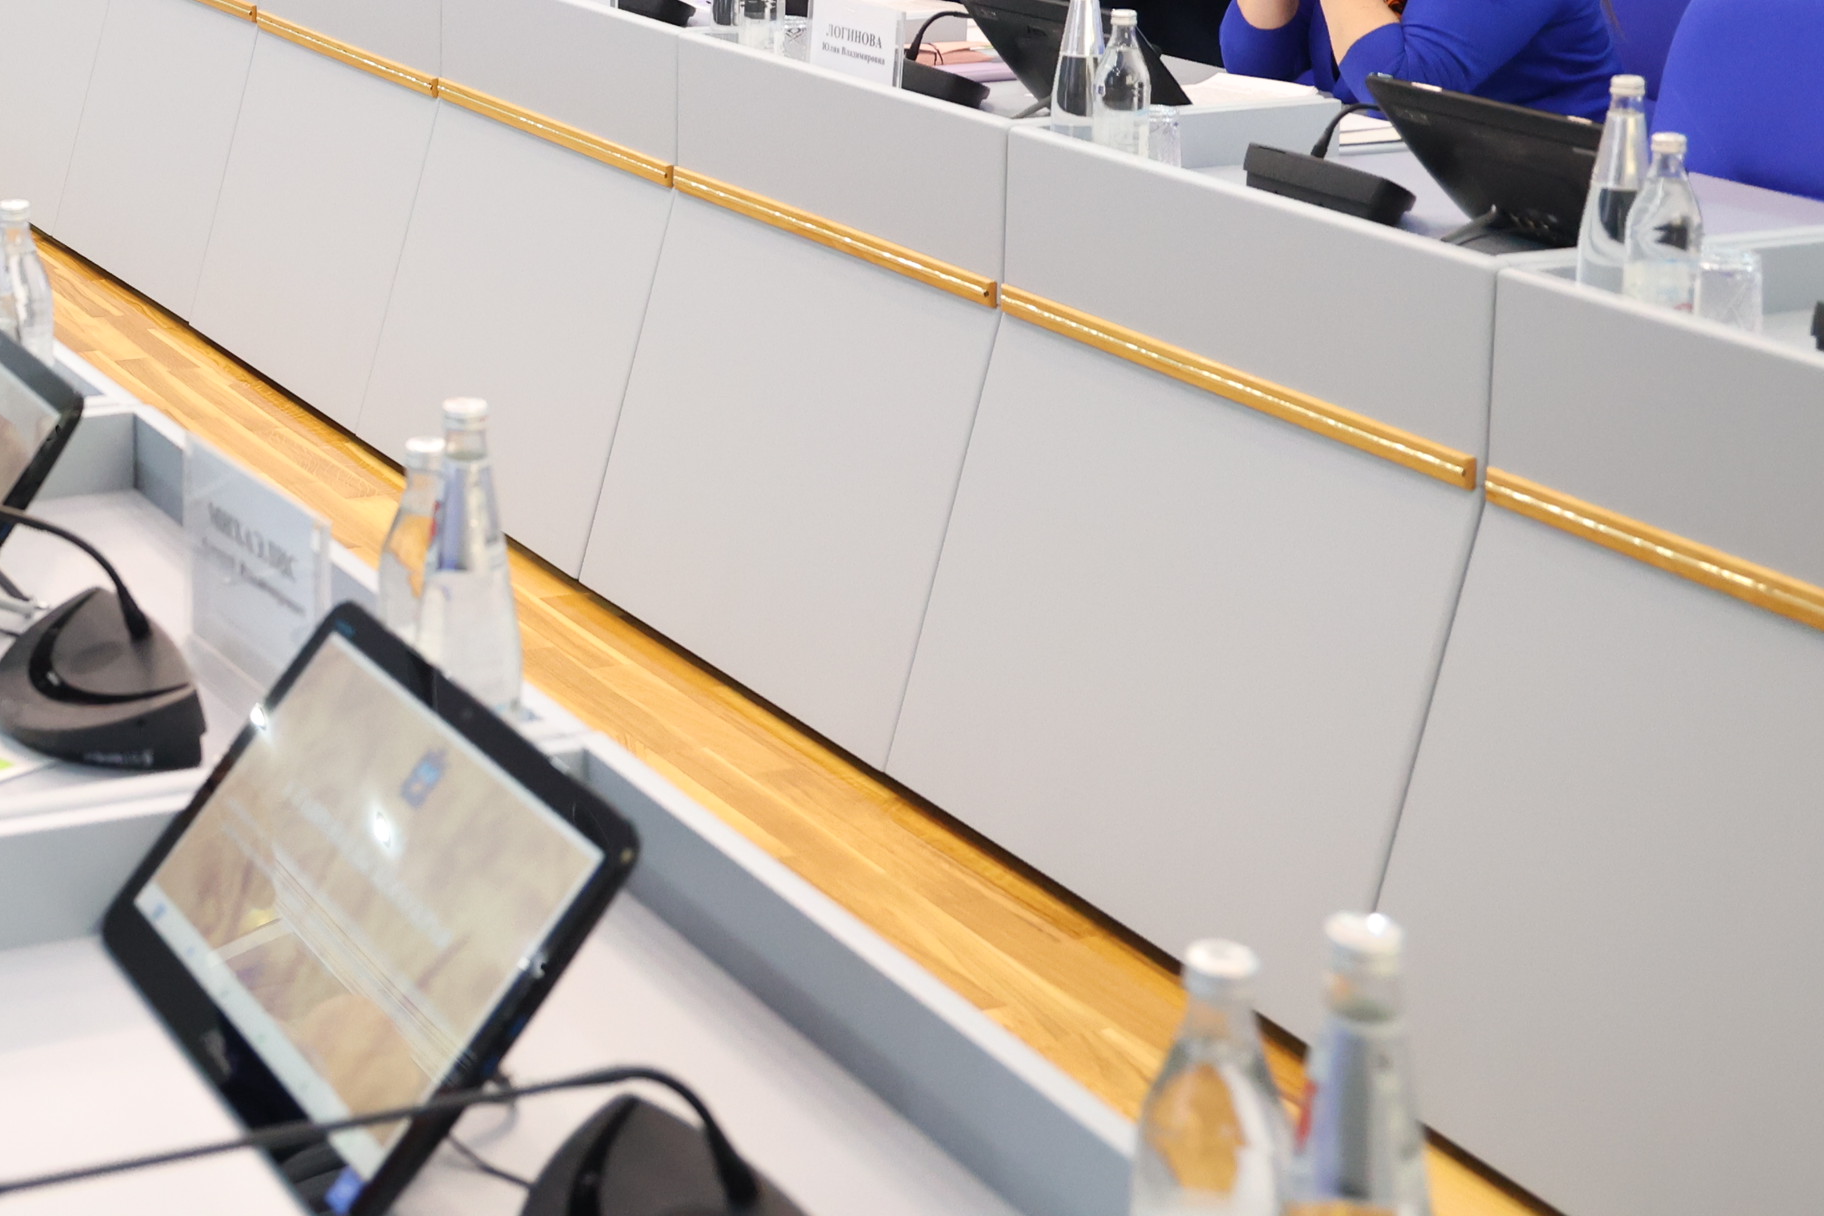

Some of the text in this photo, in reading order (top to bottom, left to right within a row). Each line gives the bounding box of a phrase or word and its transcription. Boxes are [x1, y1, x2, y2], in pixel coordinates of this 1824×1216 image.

[826, 23, 882, 49] ЛОГИНОВА
[822, 41, 885, 65] Юлия Владимировна
